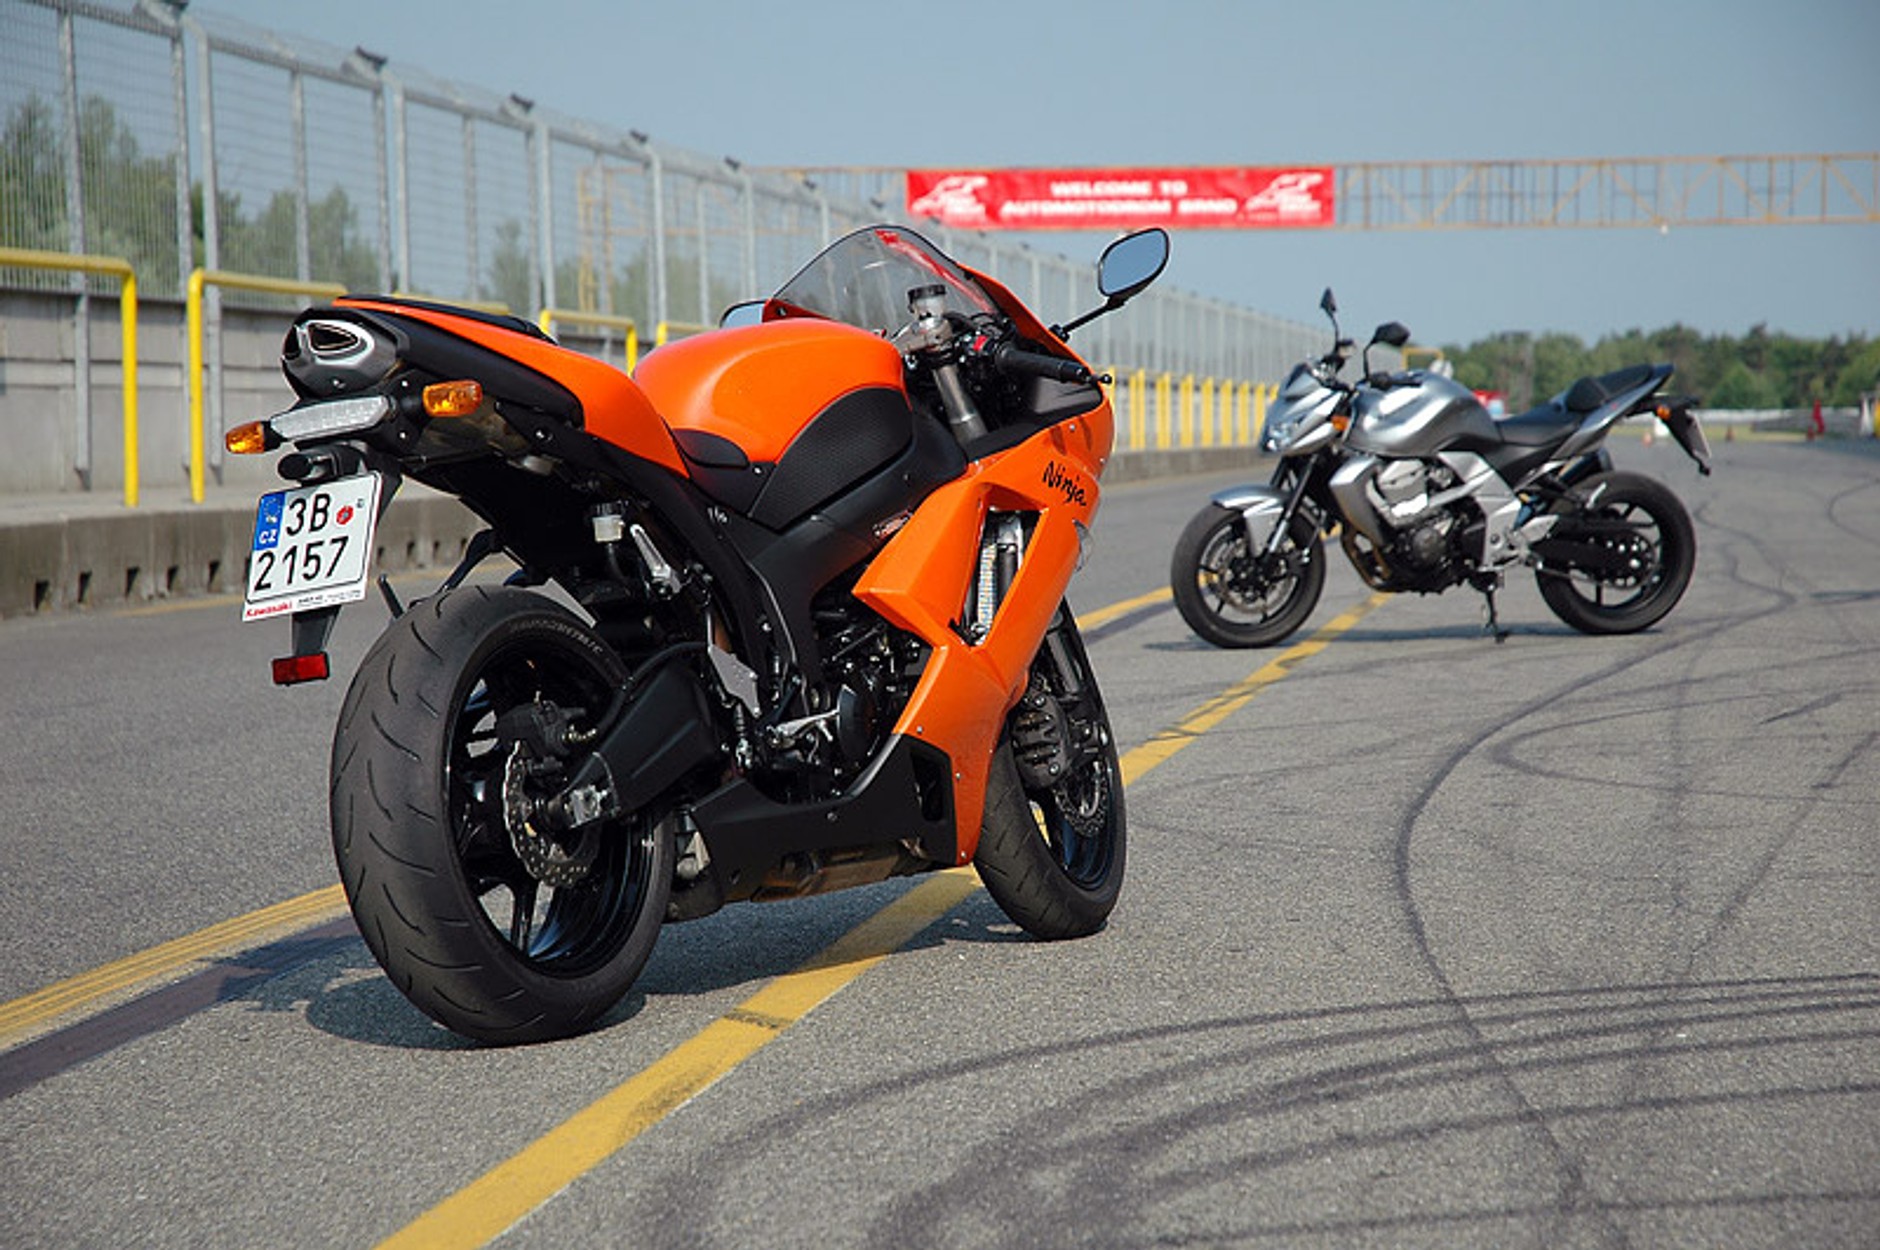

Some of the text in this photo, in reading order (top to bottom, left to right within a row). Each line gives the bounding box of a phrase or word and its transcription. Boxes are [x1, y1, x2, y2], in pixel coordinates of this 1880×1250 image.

[1050, 180, 1188, 197] WELCOME TO
[999, 200, 1172, 216] AUTOMOTODROM
[1179, 198, 1238, 214] BRNO
[1042, 460, 1087, 506] Ninja
[286, 494, 332, 536] 3B
[259, 530, 277, 544] CZ
[254, 536, 349, 591] 2157
[246, 601, 292, 617] Kawasaki
